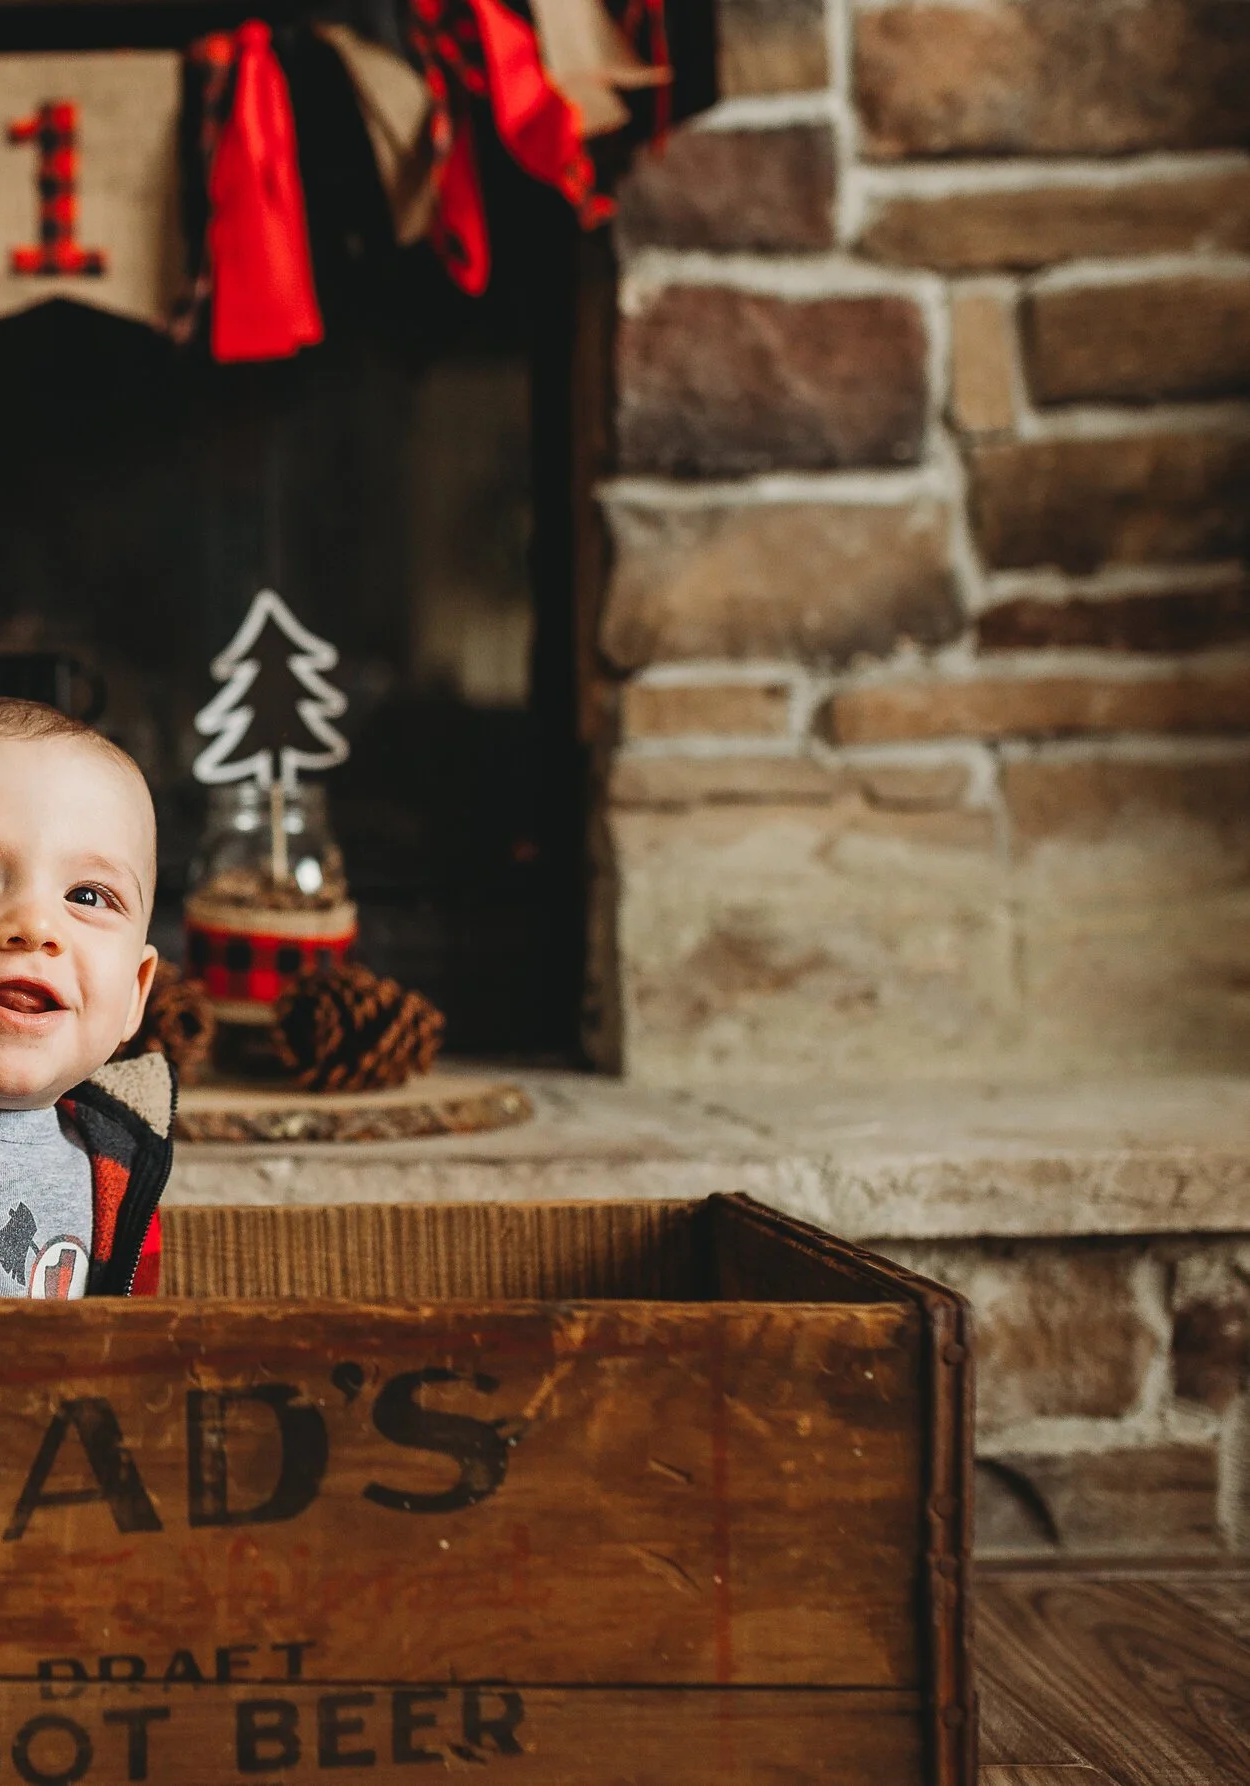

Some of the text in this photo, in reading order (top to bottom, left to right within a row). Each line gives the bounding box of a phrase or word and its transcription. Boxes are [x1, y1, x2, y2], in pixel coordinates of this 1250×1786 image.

[5, 98, 109, 278] 1
[36, 1641, 317, 1700] DRAFT
[235, 1680, 524, 1774] BEER
